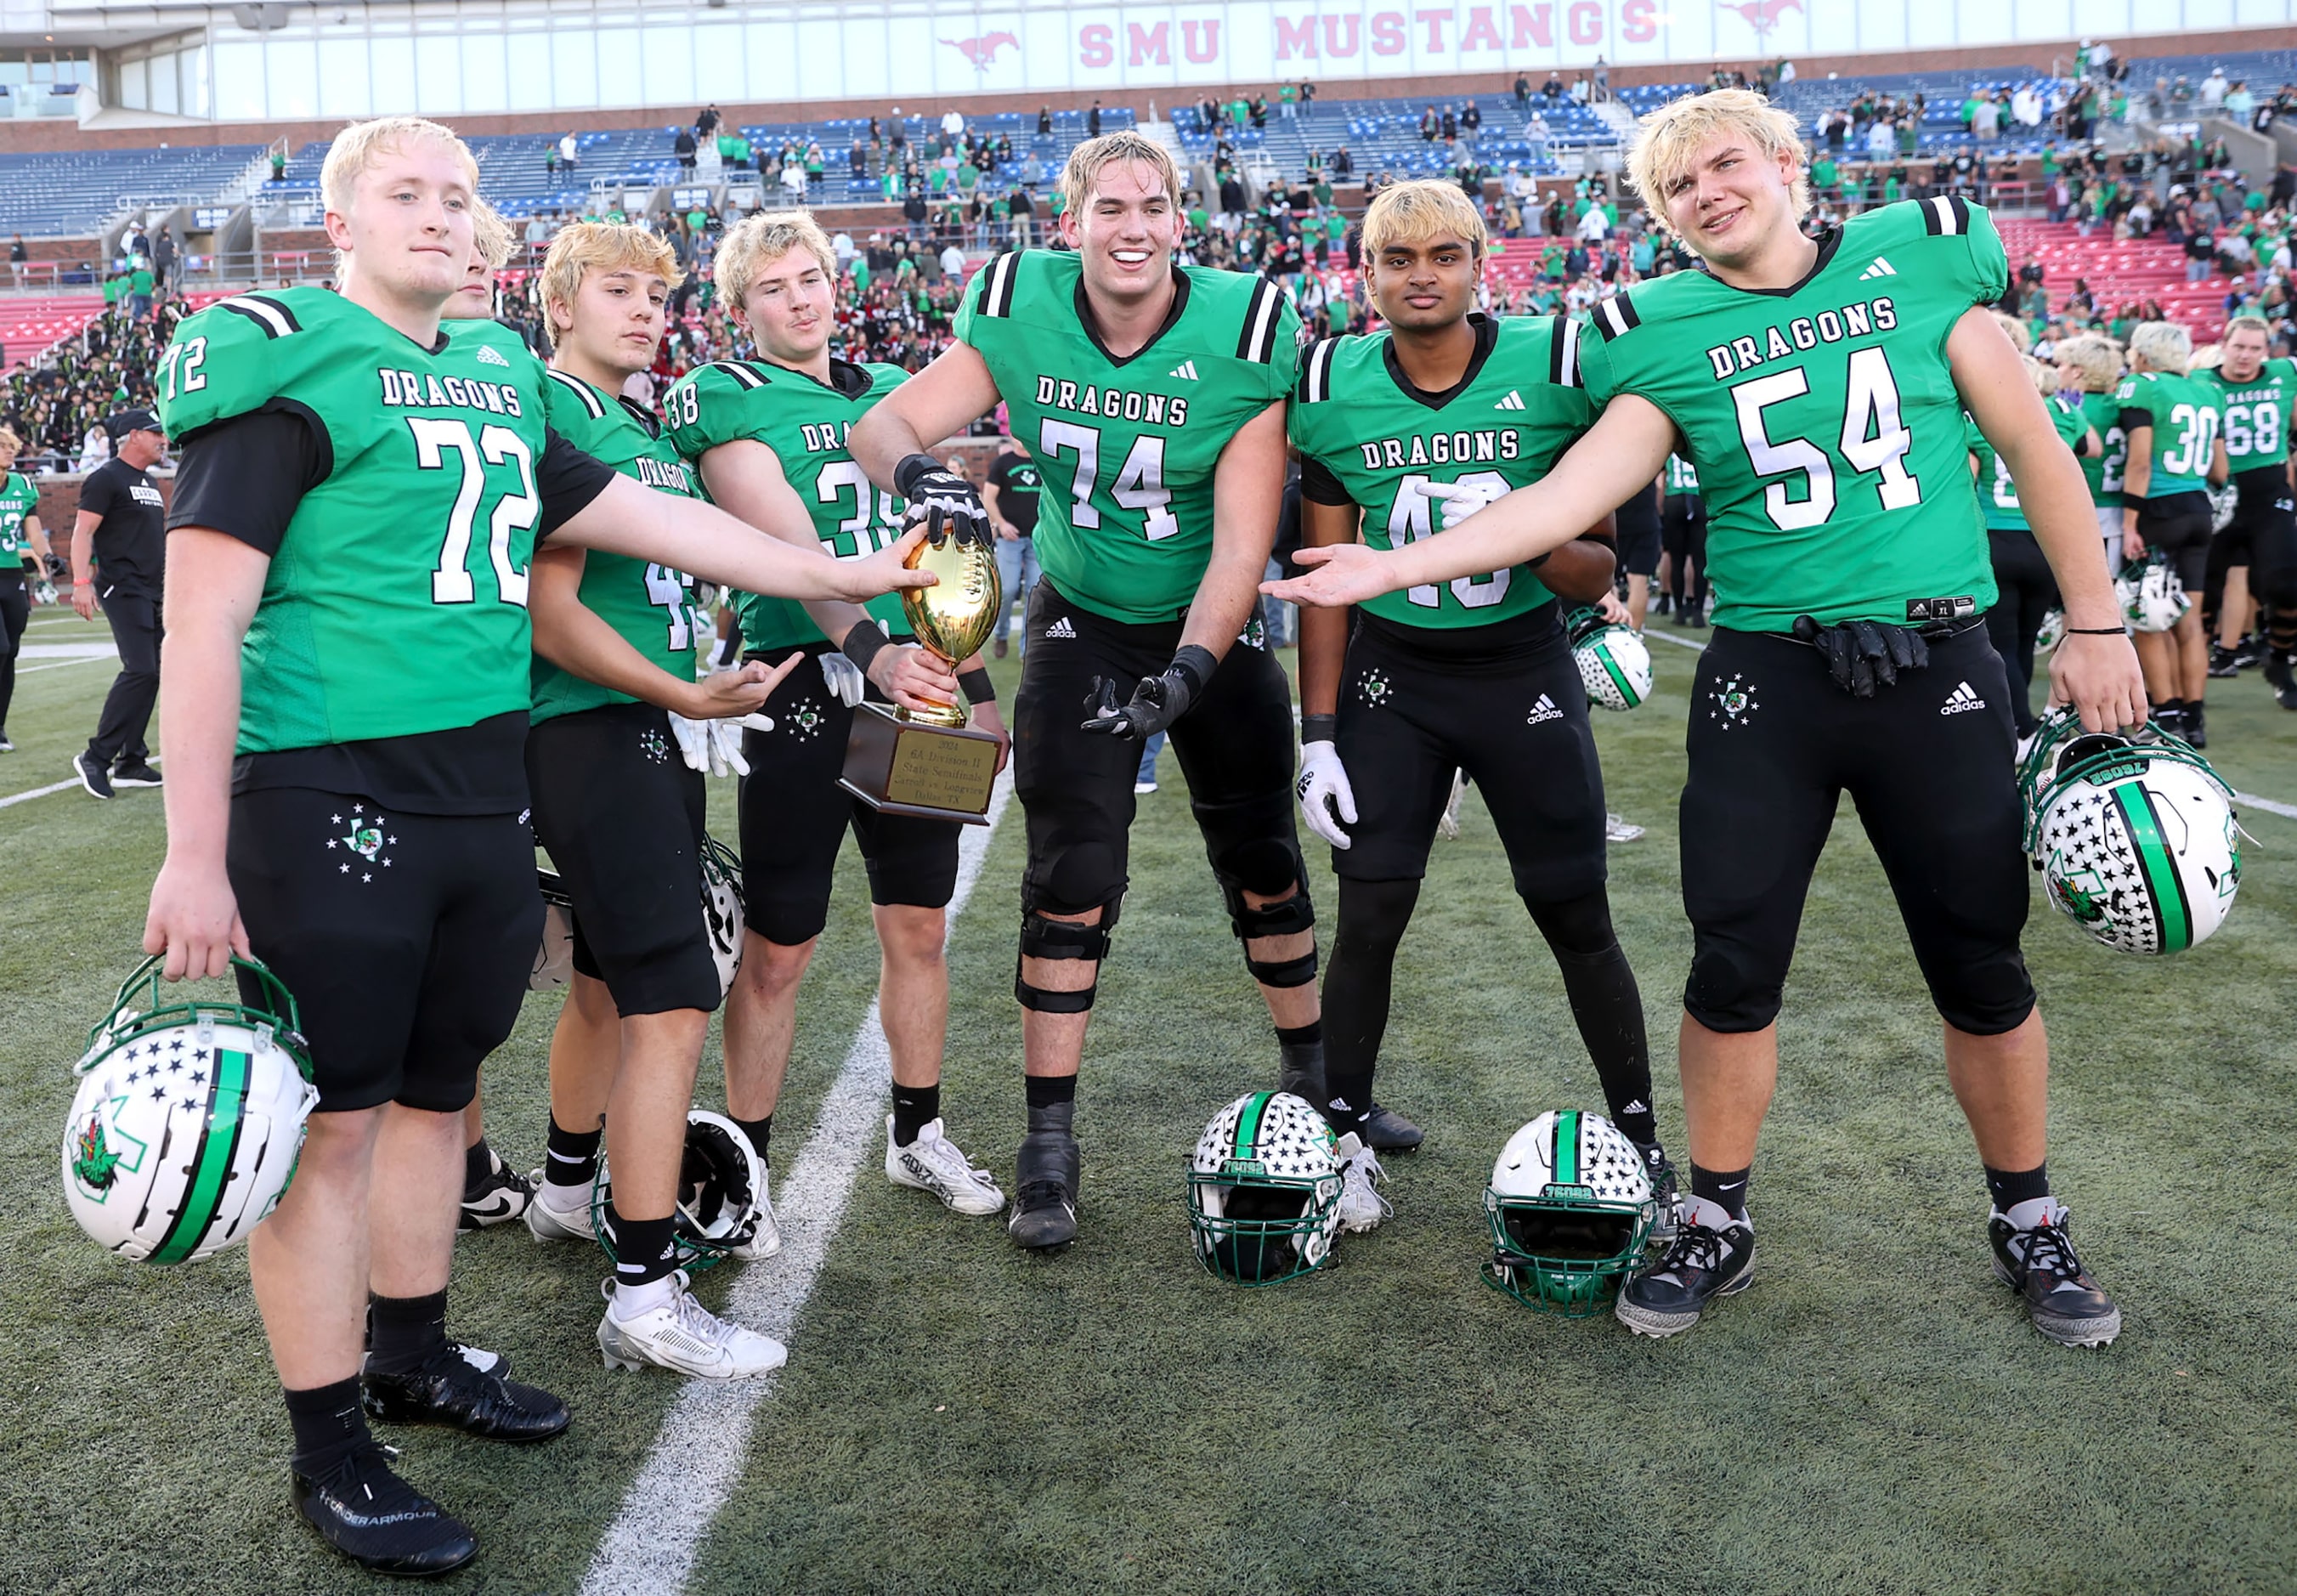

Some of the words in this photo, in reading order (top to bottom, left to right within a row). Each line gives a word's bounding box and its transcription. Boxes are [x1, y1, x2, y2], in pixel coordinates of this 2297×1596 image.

[1079, 19, 1221, 68] SMU
[1275, 0, 1657, 60] MUSTANGS
[1706, 297, 1898, 380] DRAGONS
[164, 335, 208, 402] 72
[378, 367, 523, 418] DRAGONS
[665, 382, 699, 431] 38
[1036, 375, 1189, 427] DRAGONS
[2116, 382, 2136, 400] 30
[2226, 388, 2281, 404] RAGONS
[1728, 344, 1922, 531] 54
[2163, 403, 2221, 477] 30
[2224, 402, 2280, 456] 68
[1360, 428, 1519, 469] DRAGONS
[636, 457, 693, 494] DRAGO
[1040, 416, 1180, 541] 74
[405, 416, 542, 608] 72
[1938, 607, 1948, 615] XL
[1045, 629, 1077, 638] adidas
[1527, 709, 1564, 724] adidas
[1940, 699, 1986, 716] adidas
[911, 749, 924, 760] 6A
[929, 751, 969, 766] Division
[938, 740, 959, 750] 2024
[902, 761, 928, 775] State
[932, 767, 982, 782] Semifinals
[2089, 761, 2147, 786] 76092
[944, 781, 984, 795] Longview
[1224, 1160, 1264, 1174] 76092
[1545, 1185, 1592, 1199] 76092
